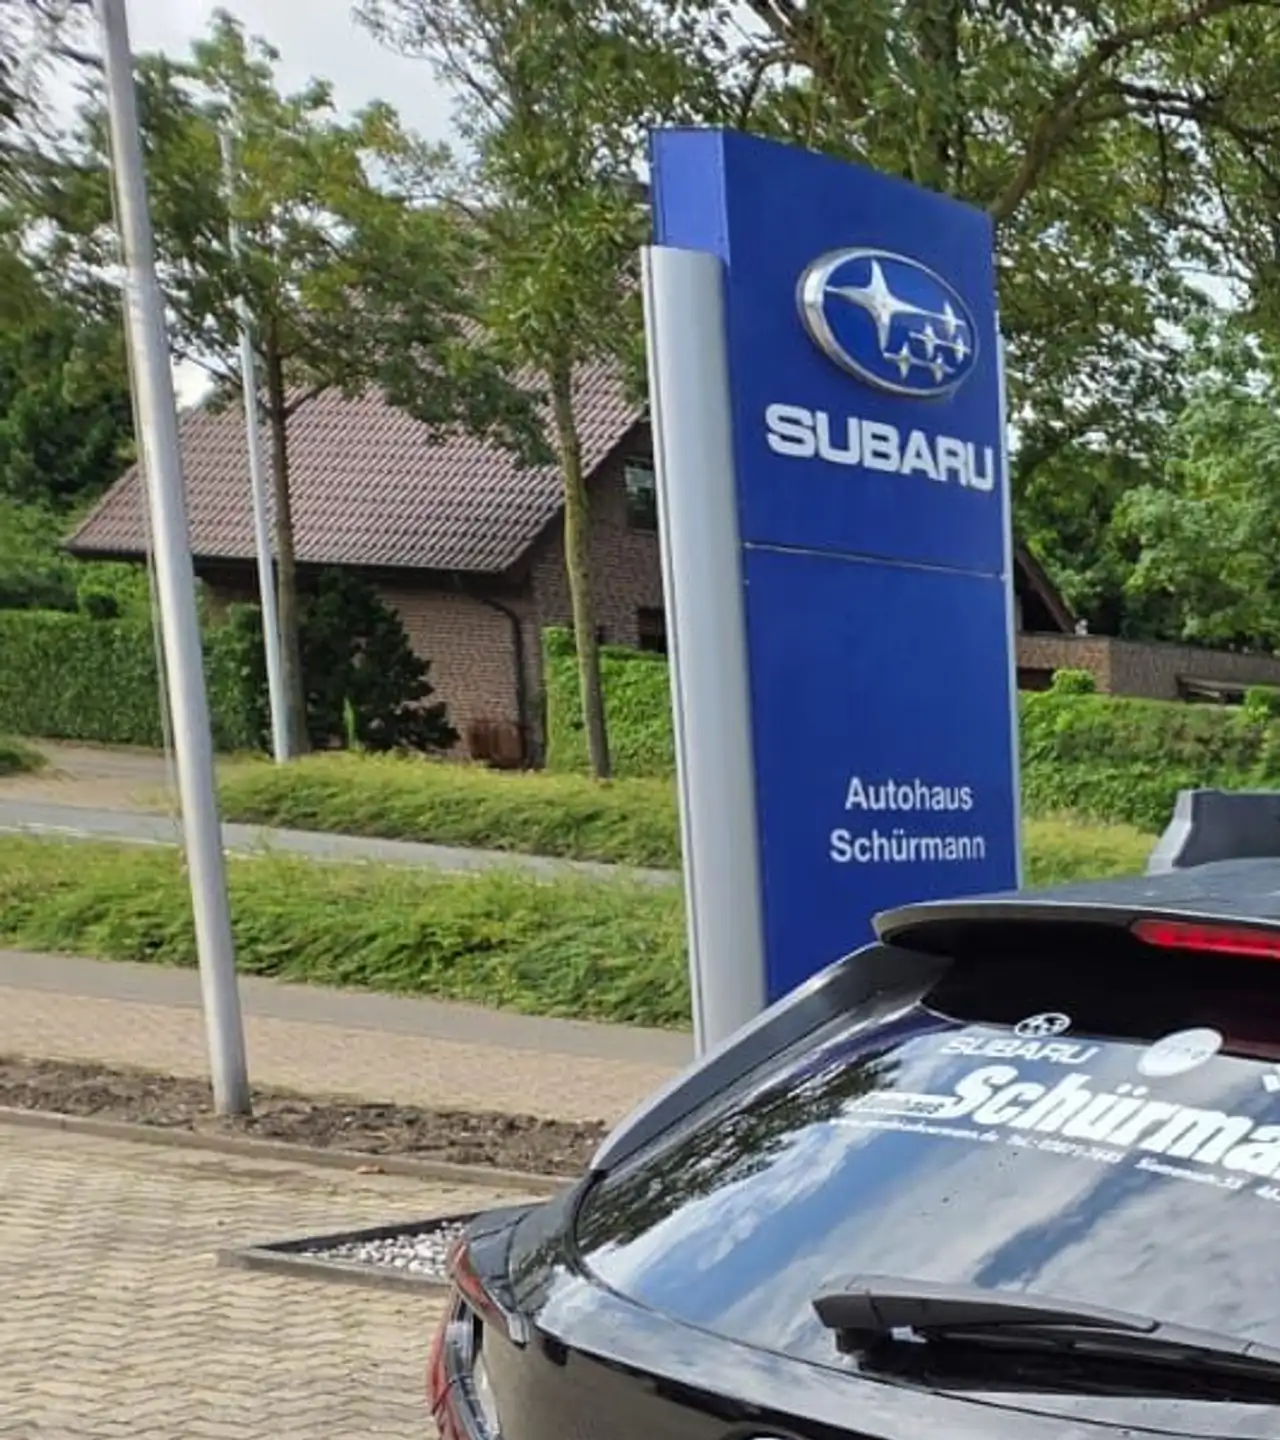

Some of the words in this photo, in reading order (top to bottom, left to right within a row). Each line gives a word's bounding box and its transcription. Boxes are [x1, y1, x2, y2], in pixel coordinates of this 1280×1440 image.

[764, 404, 996, 492] SUBARU
[845, 776, 974, 812] Autohaus
[829, 828, 986, 863] Schürmann
[941, 1036, 1100, 1065] SUBARU
